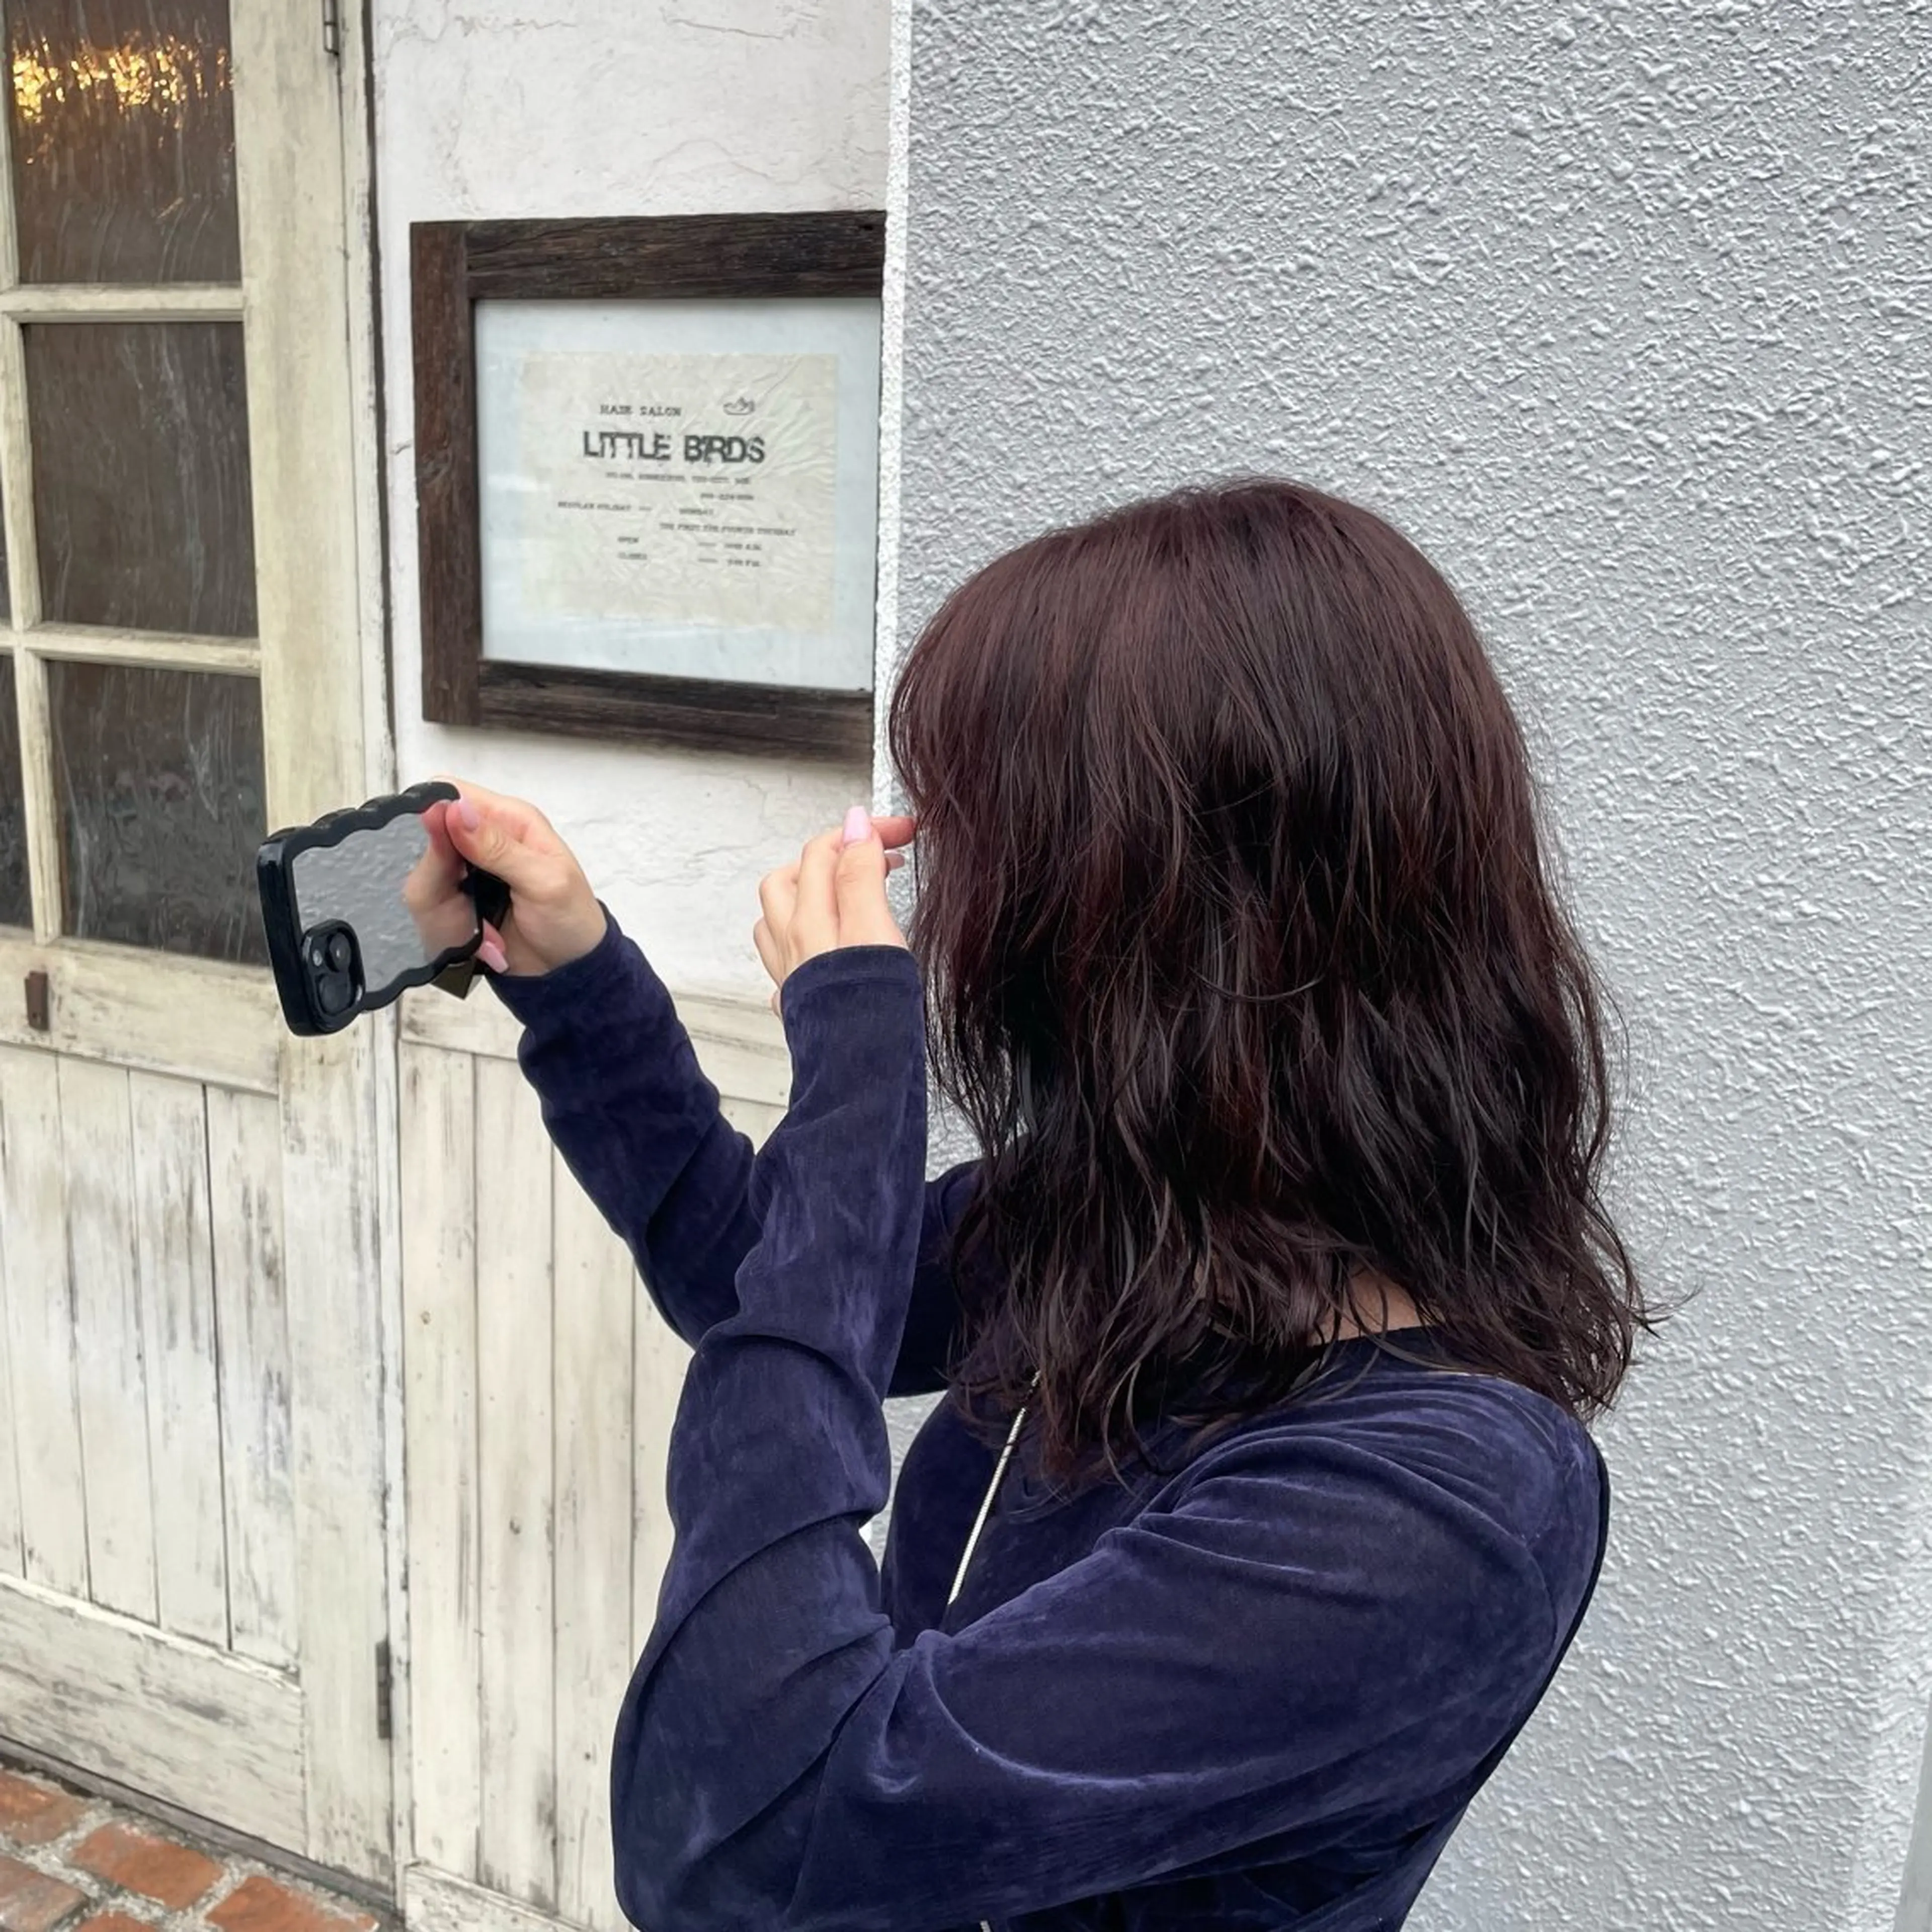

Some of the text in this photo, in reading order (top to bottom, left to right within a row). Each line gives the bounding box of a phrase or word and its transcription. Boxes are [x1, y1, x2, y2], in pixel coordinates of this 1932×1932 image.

[640, 406, 682, 417] SALON
[584, 431, 766, 463] LITTLE BIRDS
